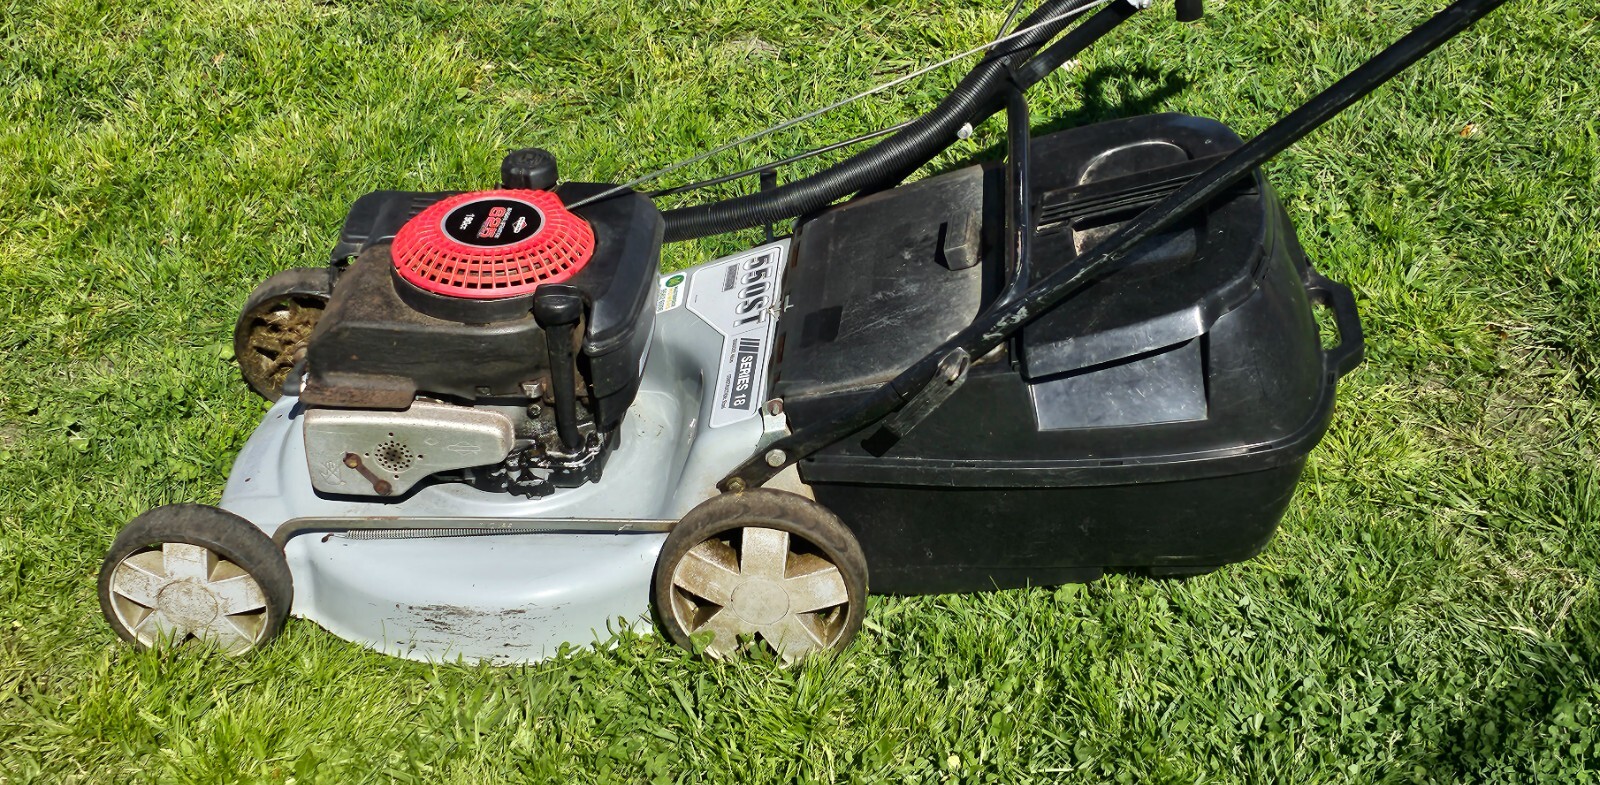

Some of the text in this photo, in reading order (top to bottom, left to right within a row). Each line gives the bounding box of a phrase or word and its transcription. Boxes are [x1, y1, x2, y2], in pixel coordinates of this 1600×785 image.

[479, 207, 506, 238] 625
[733, 253, 775, 327] 550ST
[733, 355, 753, 406] SERIES 18
